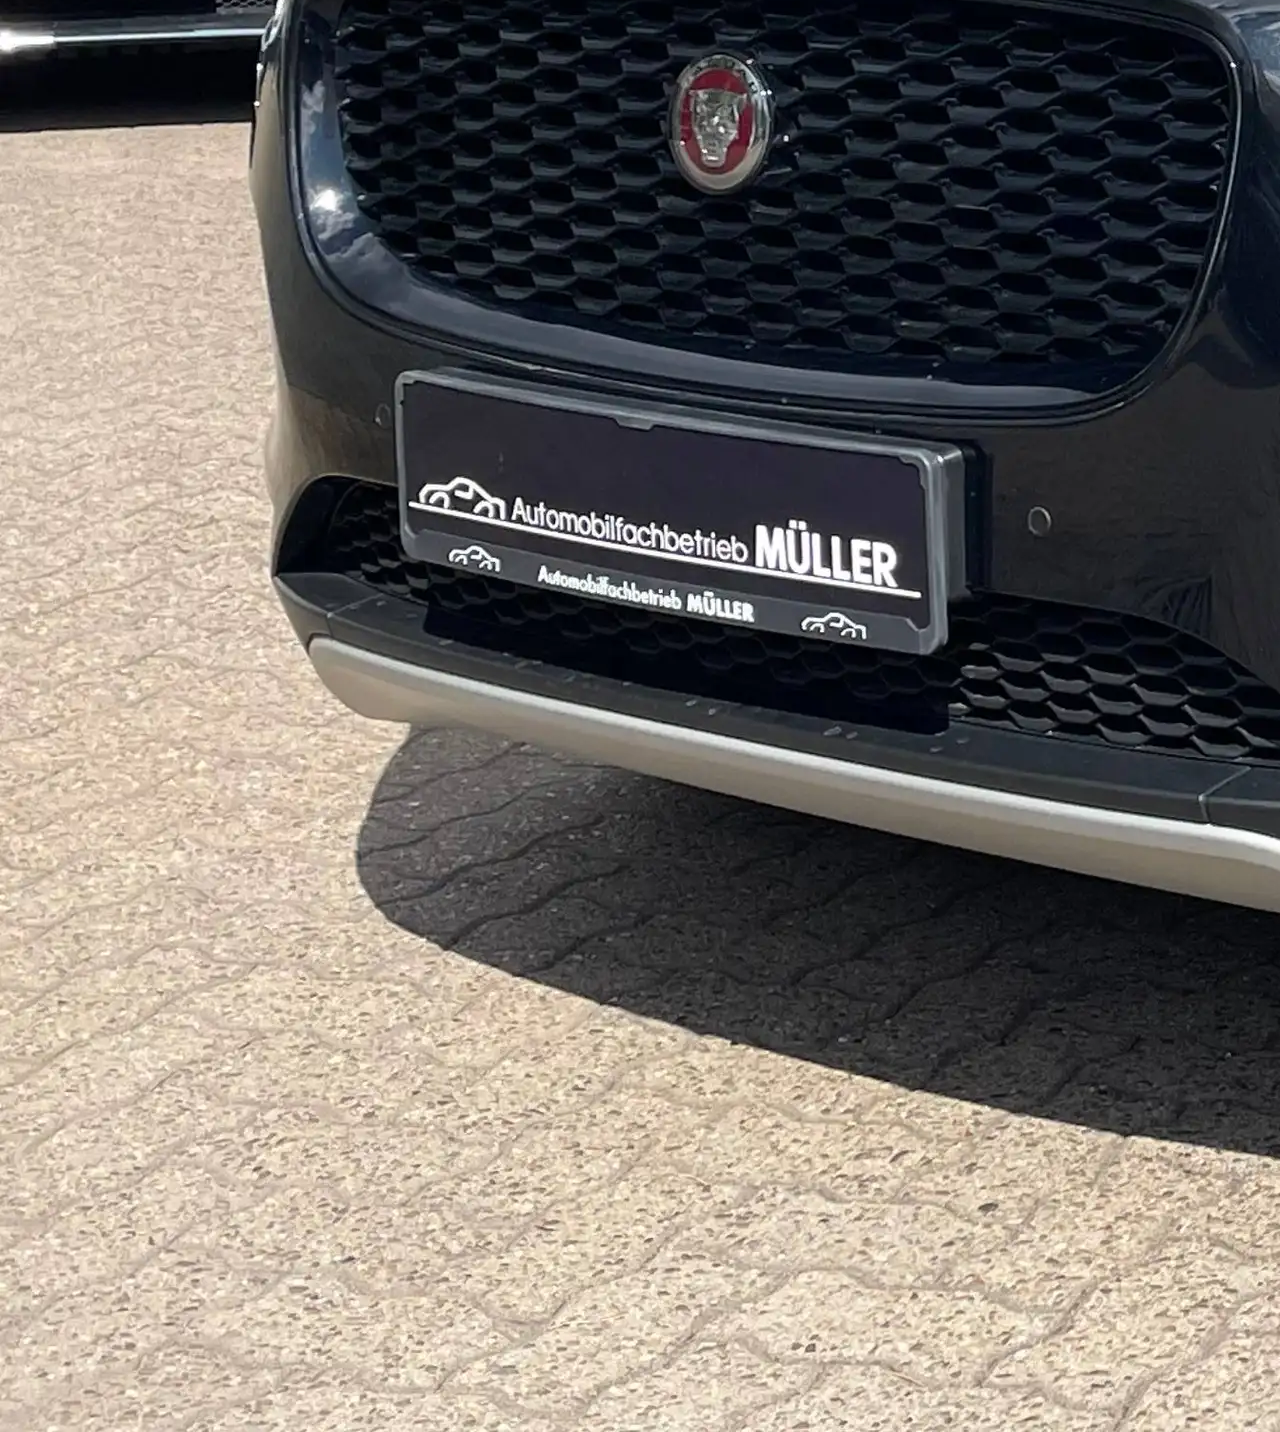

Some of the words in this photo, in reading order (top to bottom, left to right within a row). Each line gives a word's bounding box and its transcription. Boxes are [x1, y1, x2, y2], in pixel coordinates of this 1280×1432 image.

[510, 496, 749, 564] Automobilfachbetrieb
[754, 518, 900, 589] MÜLLER
[536, 564, 682, 611] Automobilfachbetrieb
[686, 590, 756, 624] MÜLLER
